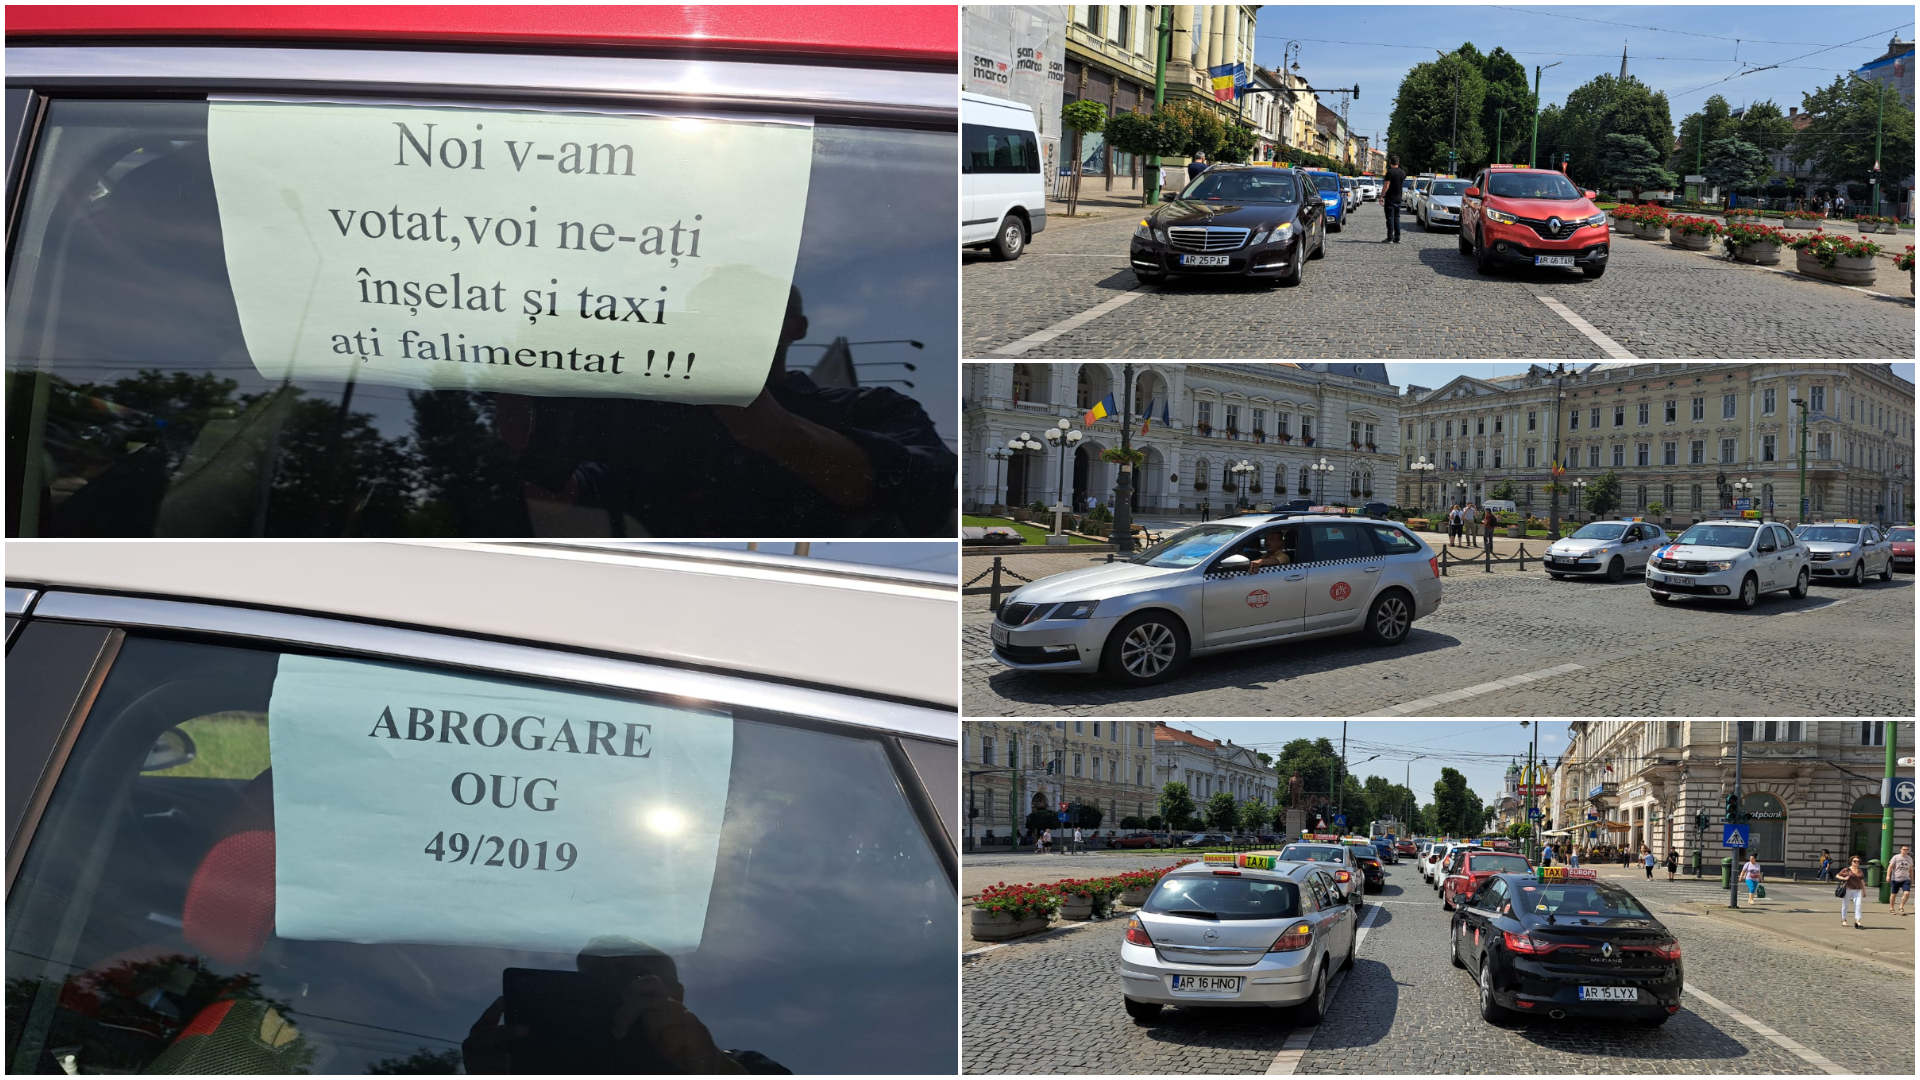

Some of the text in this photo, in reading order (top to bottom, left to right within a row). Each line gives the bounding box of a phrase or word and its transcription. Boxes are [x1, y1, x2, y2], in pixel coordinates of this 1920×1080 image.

[1017, 47, 1034, 58] san
[974, 55, 994, 69] san
[1016, 59, 1042, 72] marco
[1048, 61, 1062, 72] san
[973, 67, 1008, 84] marco
[393, 121, 637, 177] Noi v-am
[328, 204, 703, 269] votat,voi ne-ați
[1185, 255, 1228, 265] AR 25 PAF
[355, 266, 668, 326] înșelat și taxi
[331, 326, 697, 380] ați falimentat !!!
[368, 704, 652, 759] ABROGARE
[451, 772, 559, 812] OUG
[424, 831, 578, 872] 49/2019
[1246, 856, 1268, 868] TAXI
[1544, 868, 1597, 877] TAXI EUROPA
[1180, 976, 1235, 989] AR 16 HNO
[1585, 987, 1634, 999] AR 15 LYX
